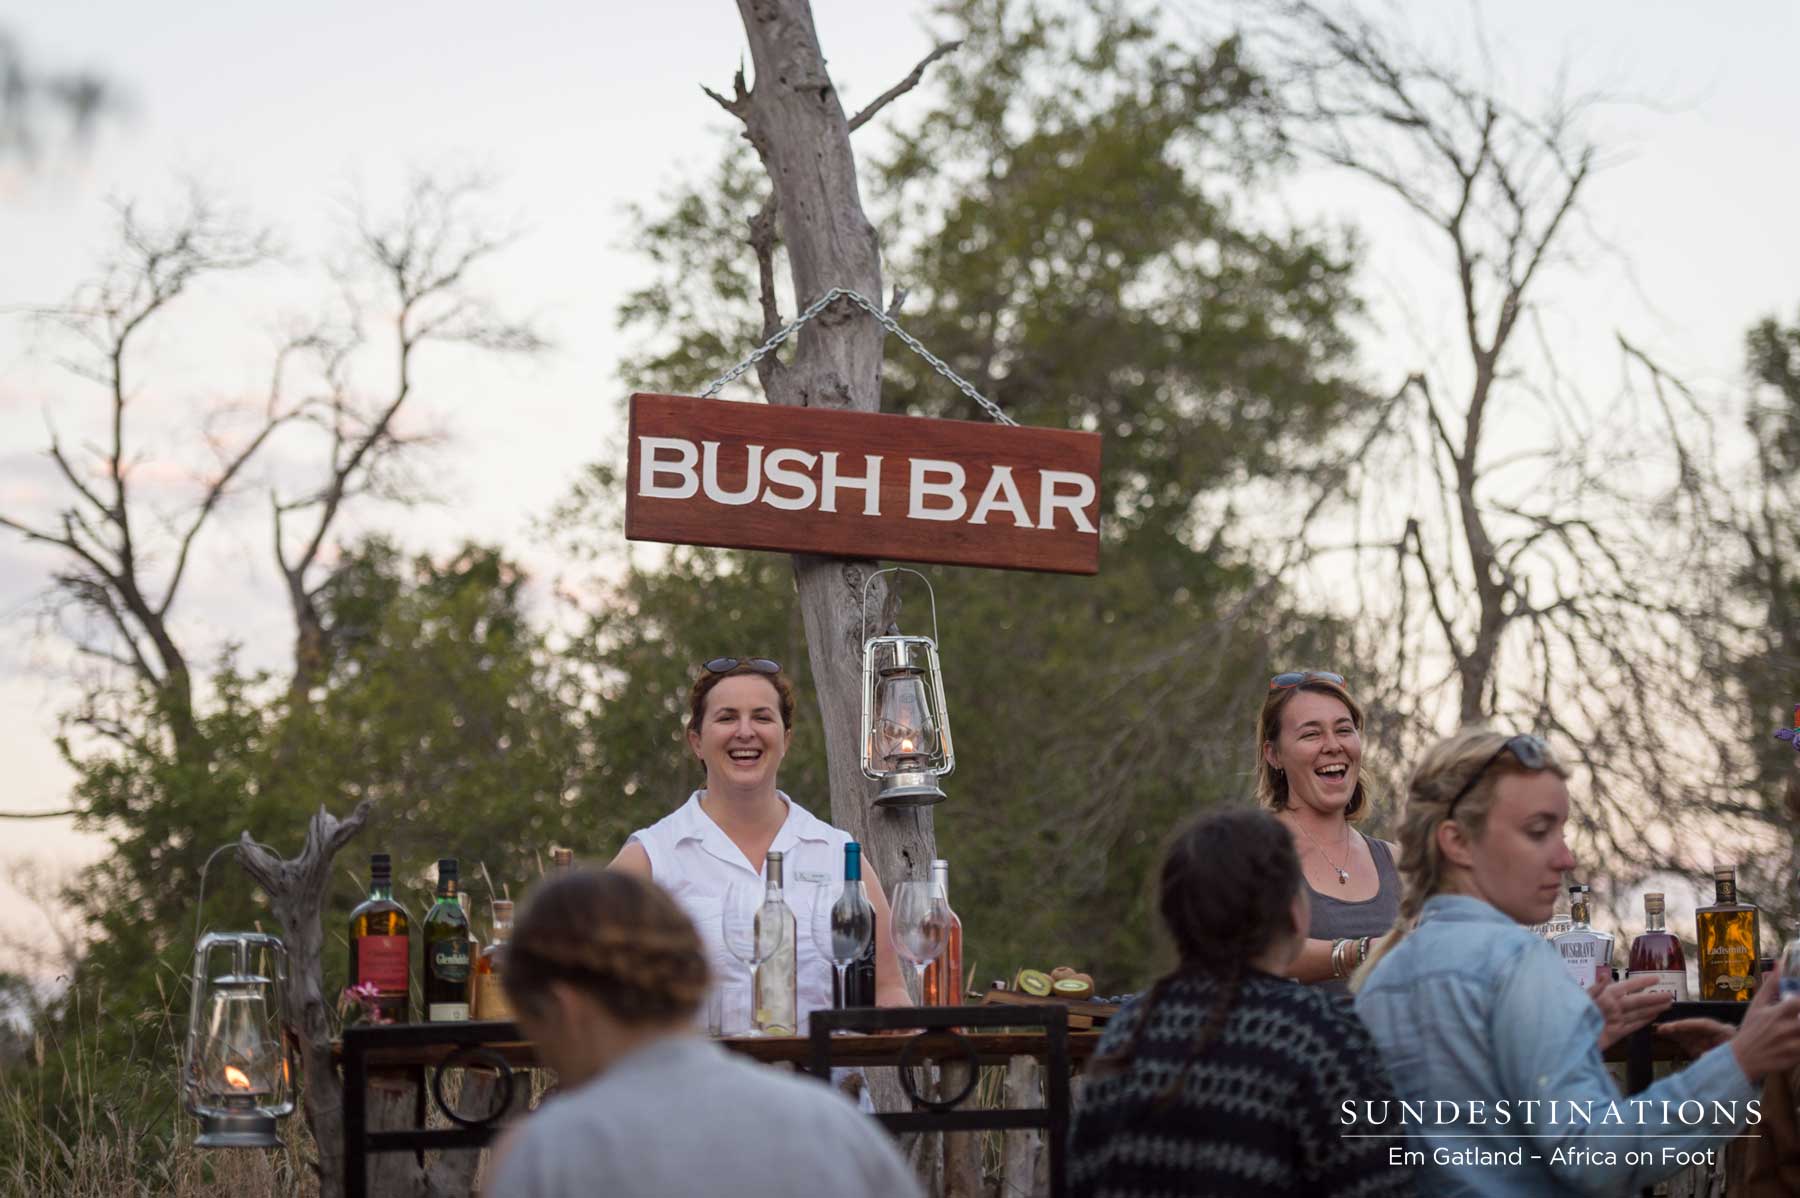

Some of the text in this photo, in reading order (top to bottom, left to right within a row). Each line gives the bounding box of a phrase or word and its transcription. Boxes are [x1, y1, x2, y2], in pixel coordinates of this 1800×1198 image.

[638, 436, 1098, 533] BUSH BAR
[1560, 942, 1595, 958] MUSGRAVE
